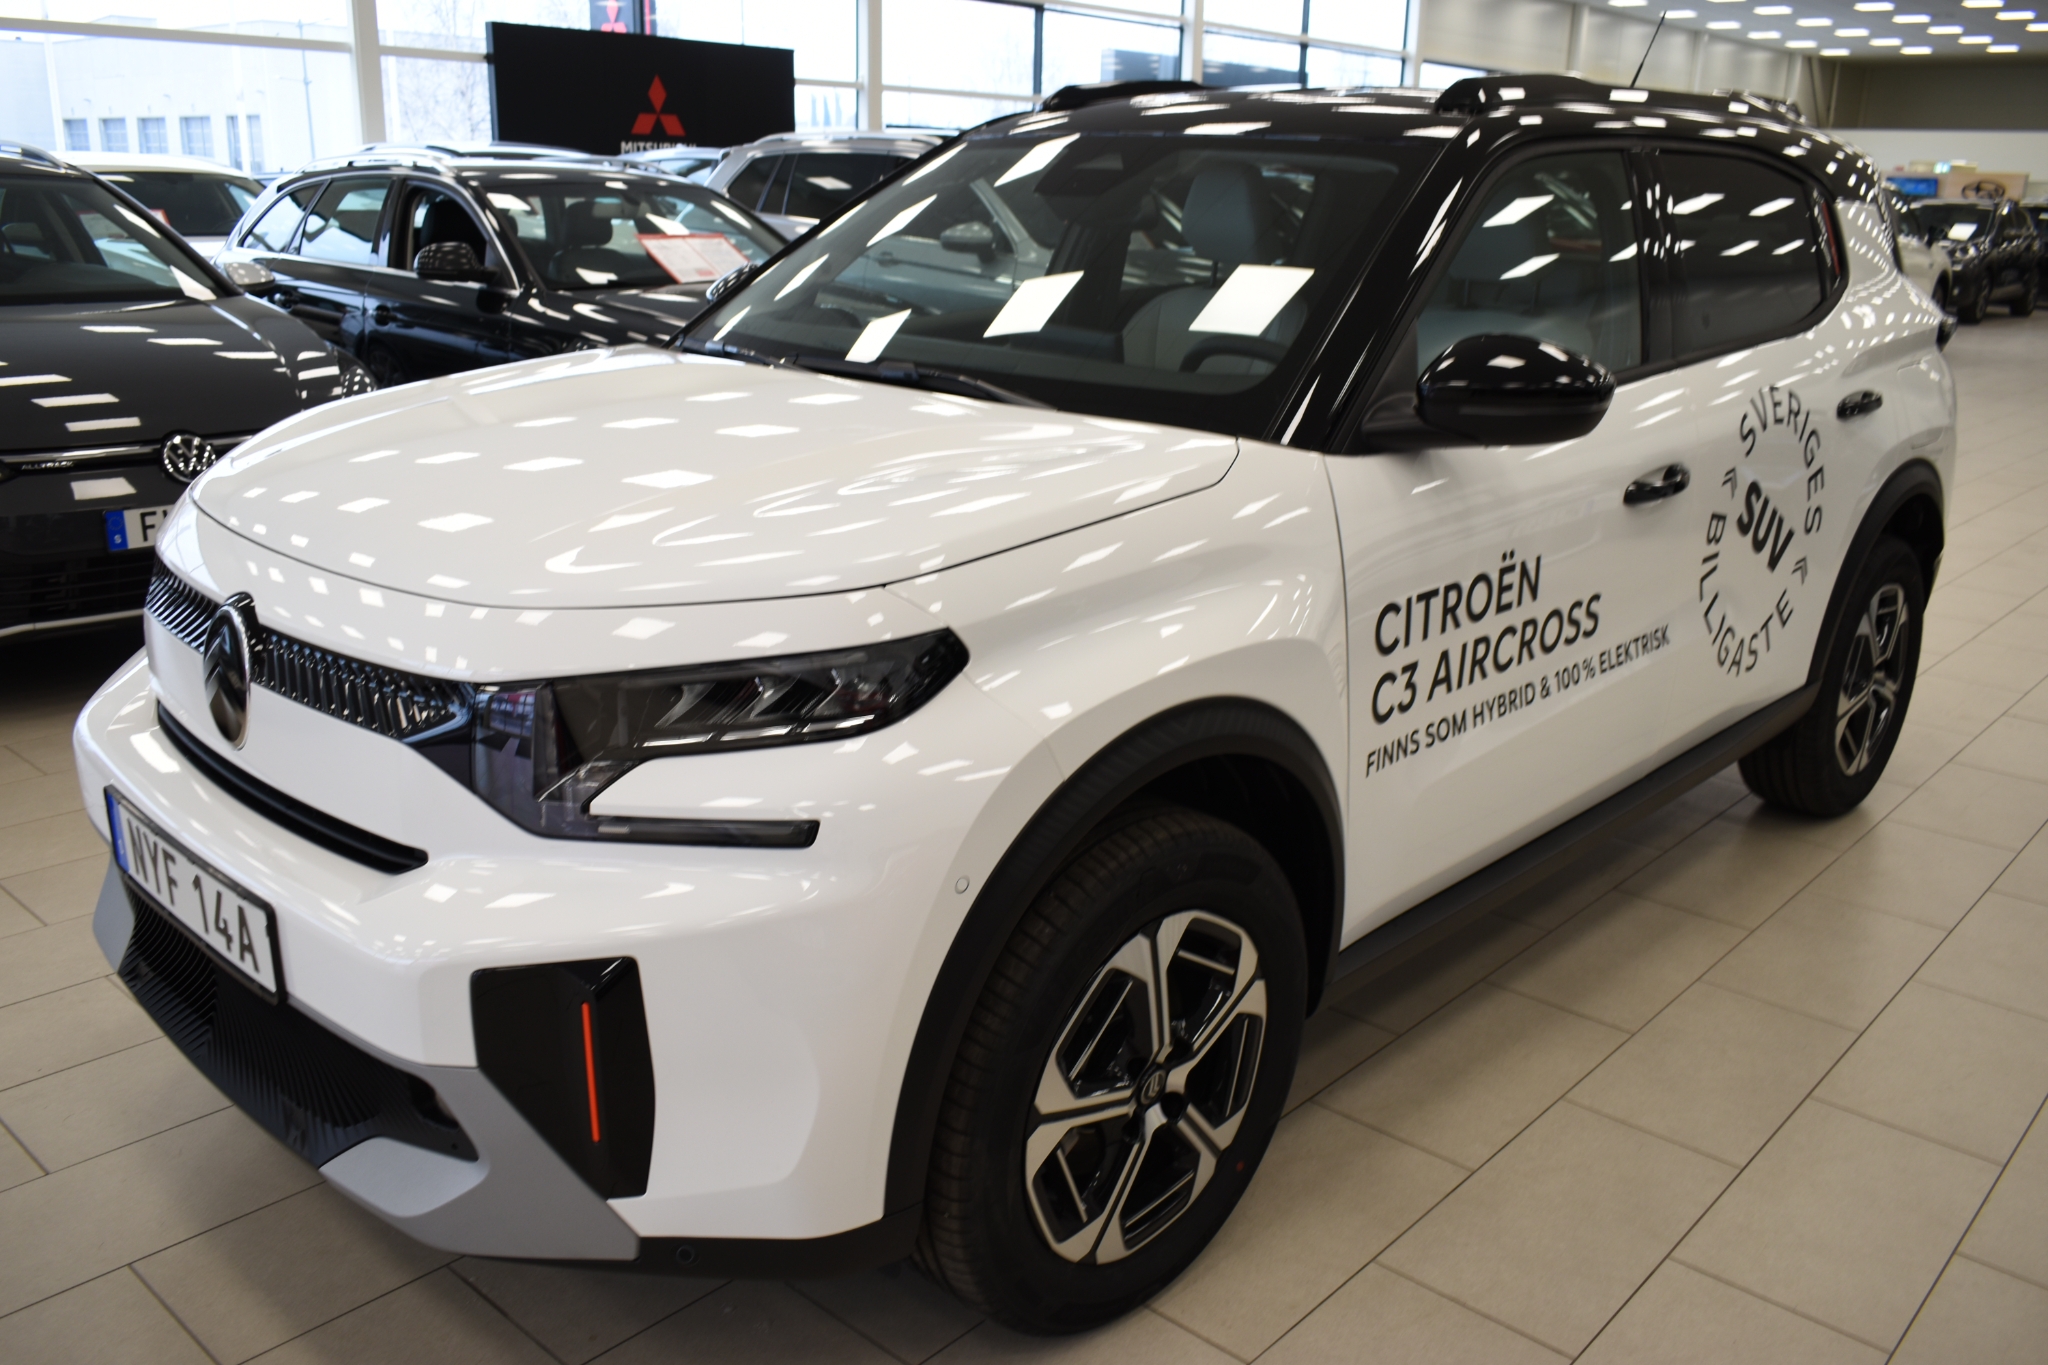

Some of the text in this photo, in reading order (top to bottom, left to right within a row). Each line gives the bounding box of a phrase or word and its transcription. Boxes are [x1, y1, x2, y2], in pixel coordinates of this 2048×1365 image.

[1736, 479, 1795, 573] SUV
[1738, 384, 1825, 535] SVERIGES
[1371, 593, 1602, 725] C3 AIRCROSS
[1375, 549, 1542, 656] CITROËN
[1699, 511, 1794, 678] BILLIGASTE
[1366, 729, 1420, 778] FINNS
[1425, 709, 1467, 748] SOM
[1472, 682, 1536, 729] HYBRID
[1540, 675, 1551, 699] &
[1599, 623, 1671, 675] ELEKTRISK
[127, 817, 260, 974] NYF 14A
